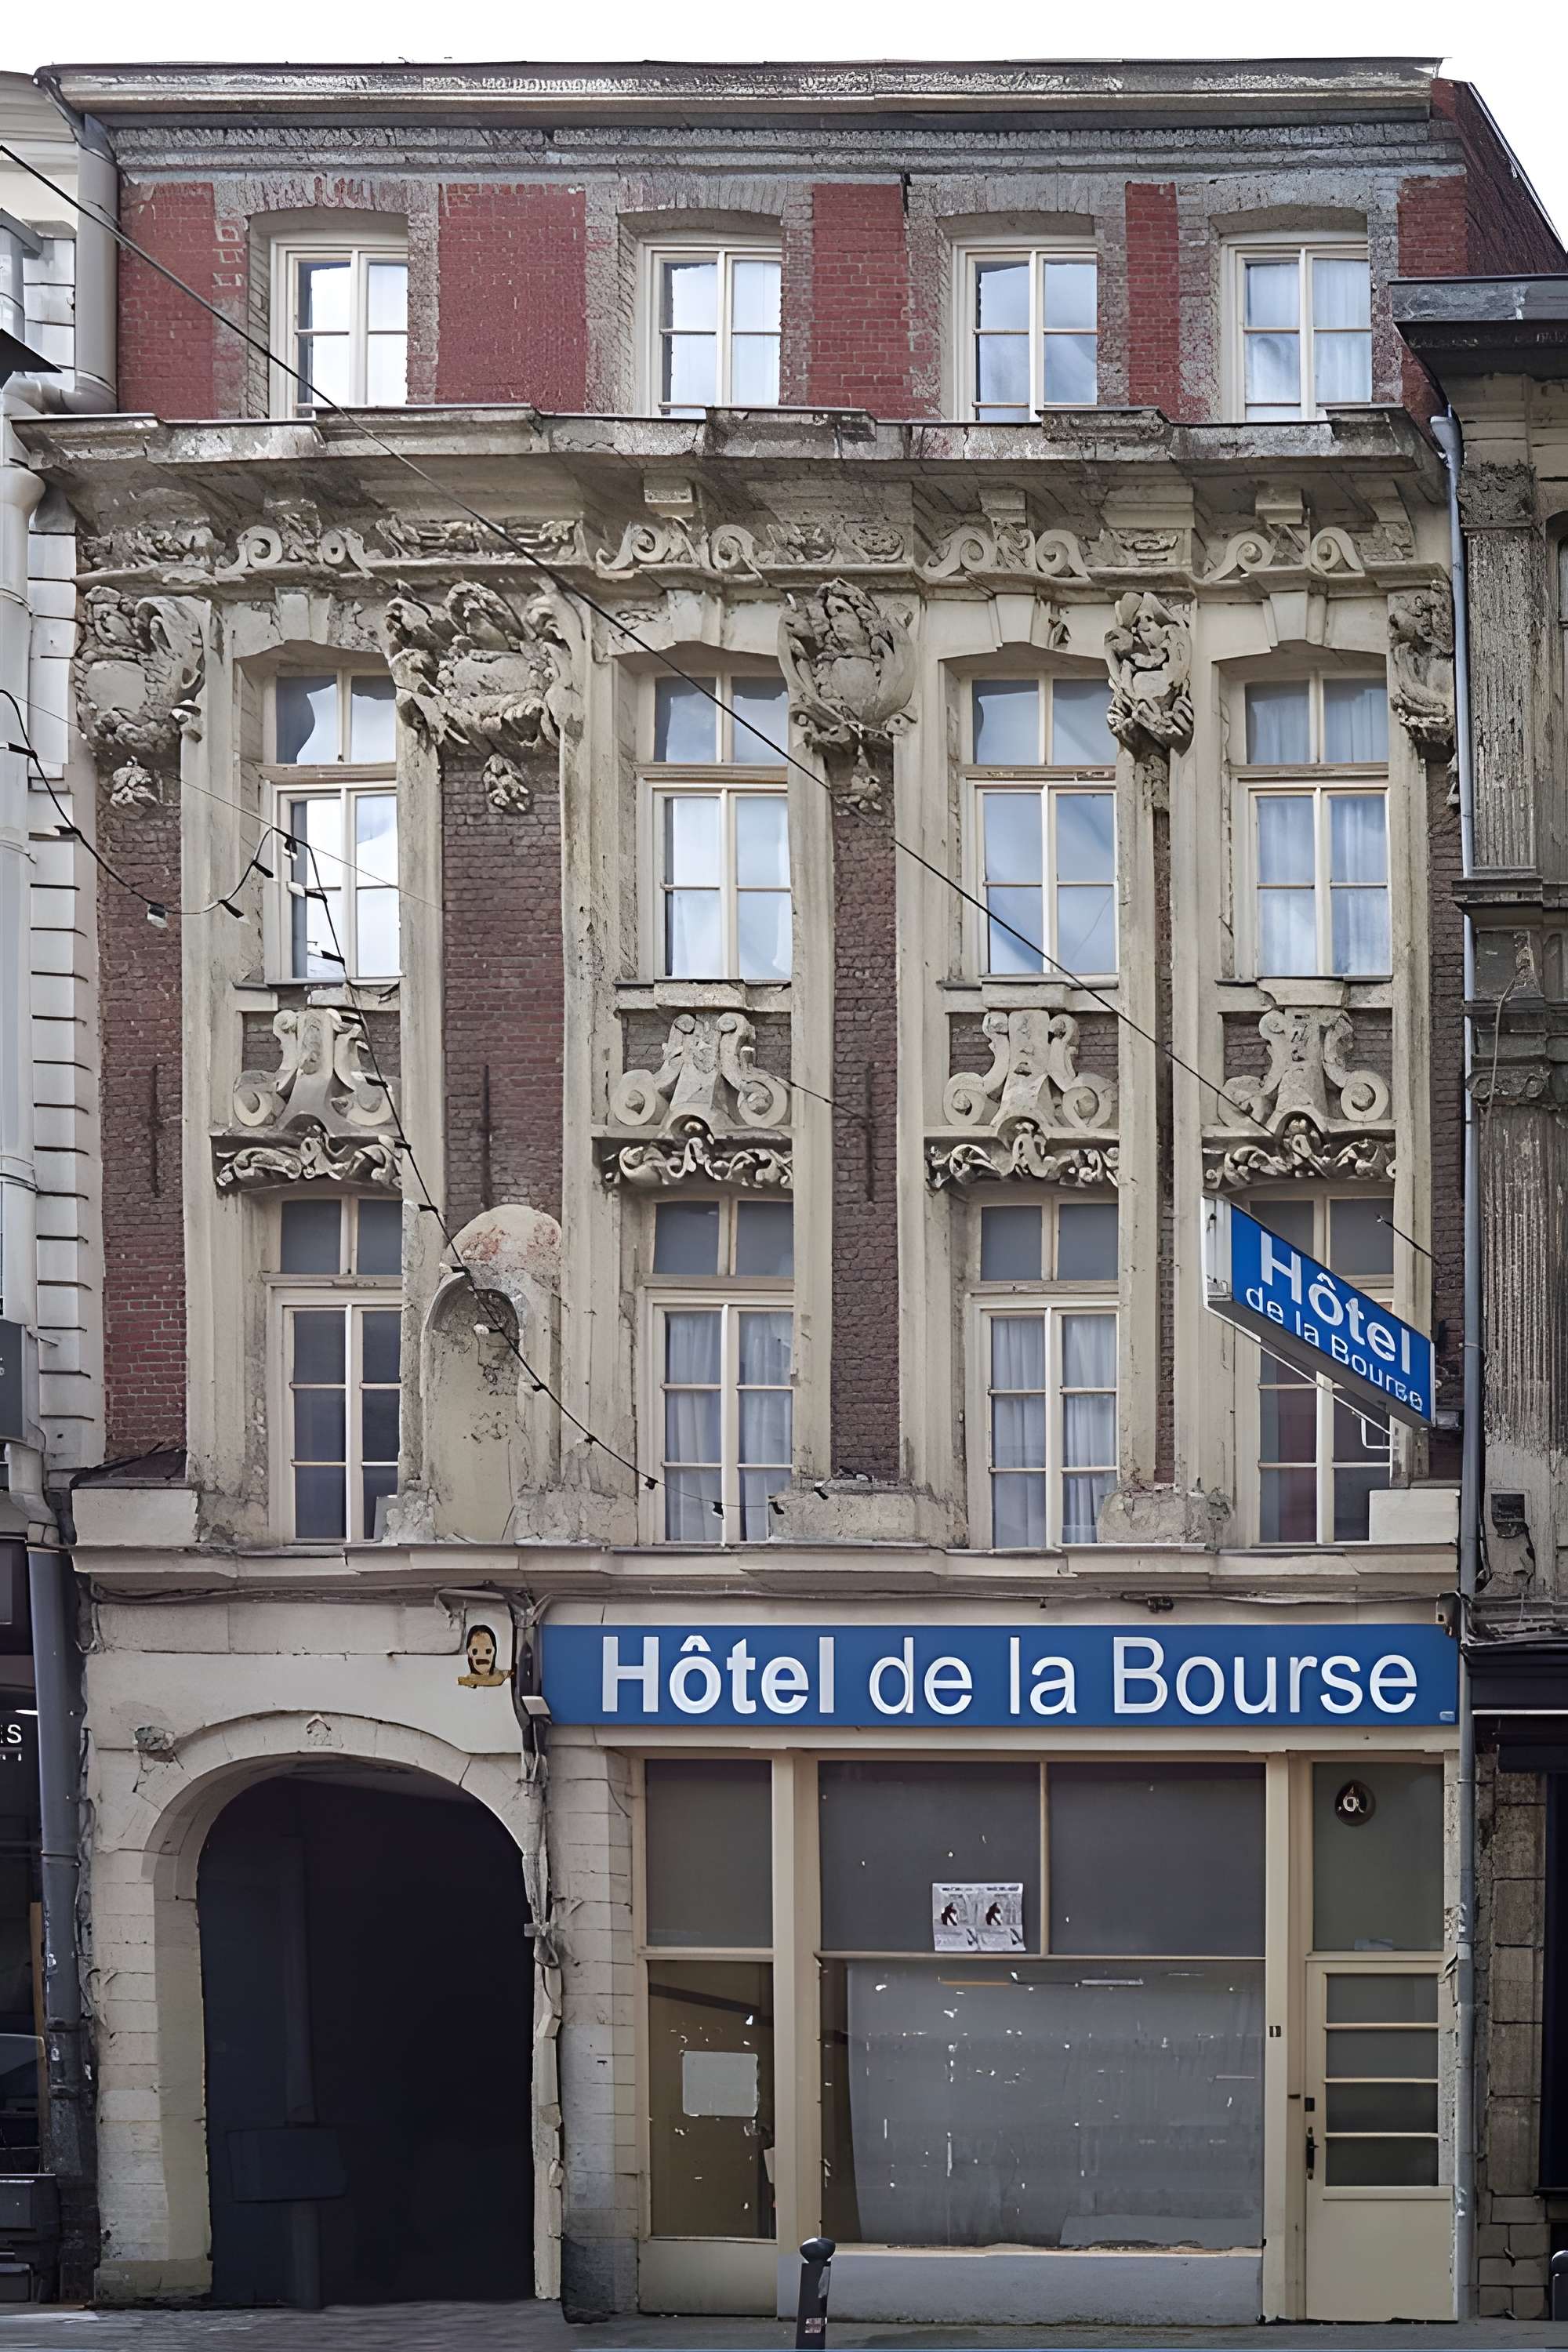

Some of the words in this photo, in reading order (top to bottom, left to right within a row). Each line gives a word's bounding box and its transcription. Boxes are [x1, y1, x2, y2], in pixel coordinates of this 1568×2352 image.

[1246, 1287, 1284, 1324] de
[1295, 1310, 1319, 1348] la
[1261, 1229, 1410, 1375] Hôtel
[601, 1635, 835, 1715] Hôtel
[869, 1636, 973, 1715] de
[1010, 1636, 1077, 1715] la
[1113, 1635, 1418, 1715] Bourse
[0, 1723, 22, 1744] S
